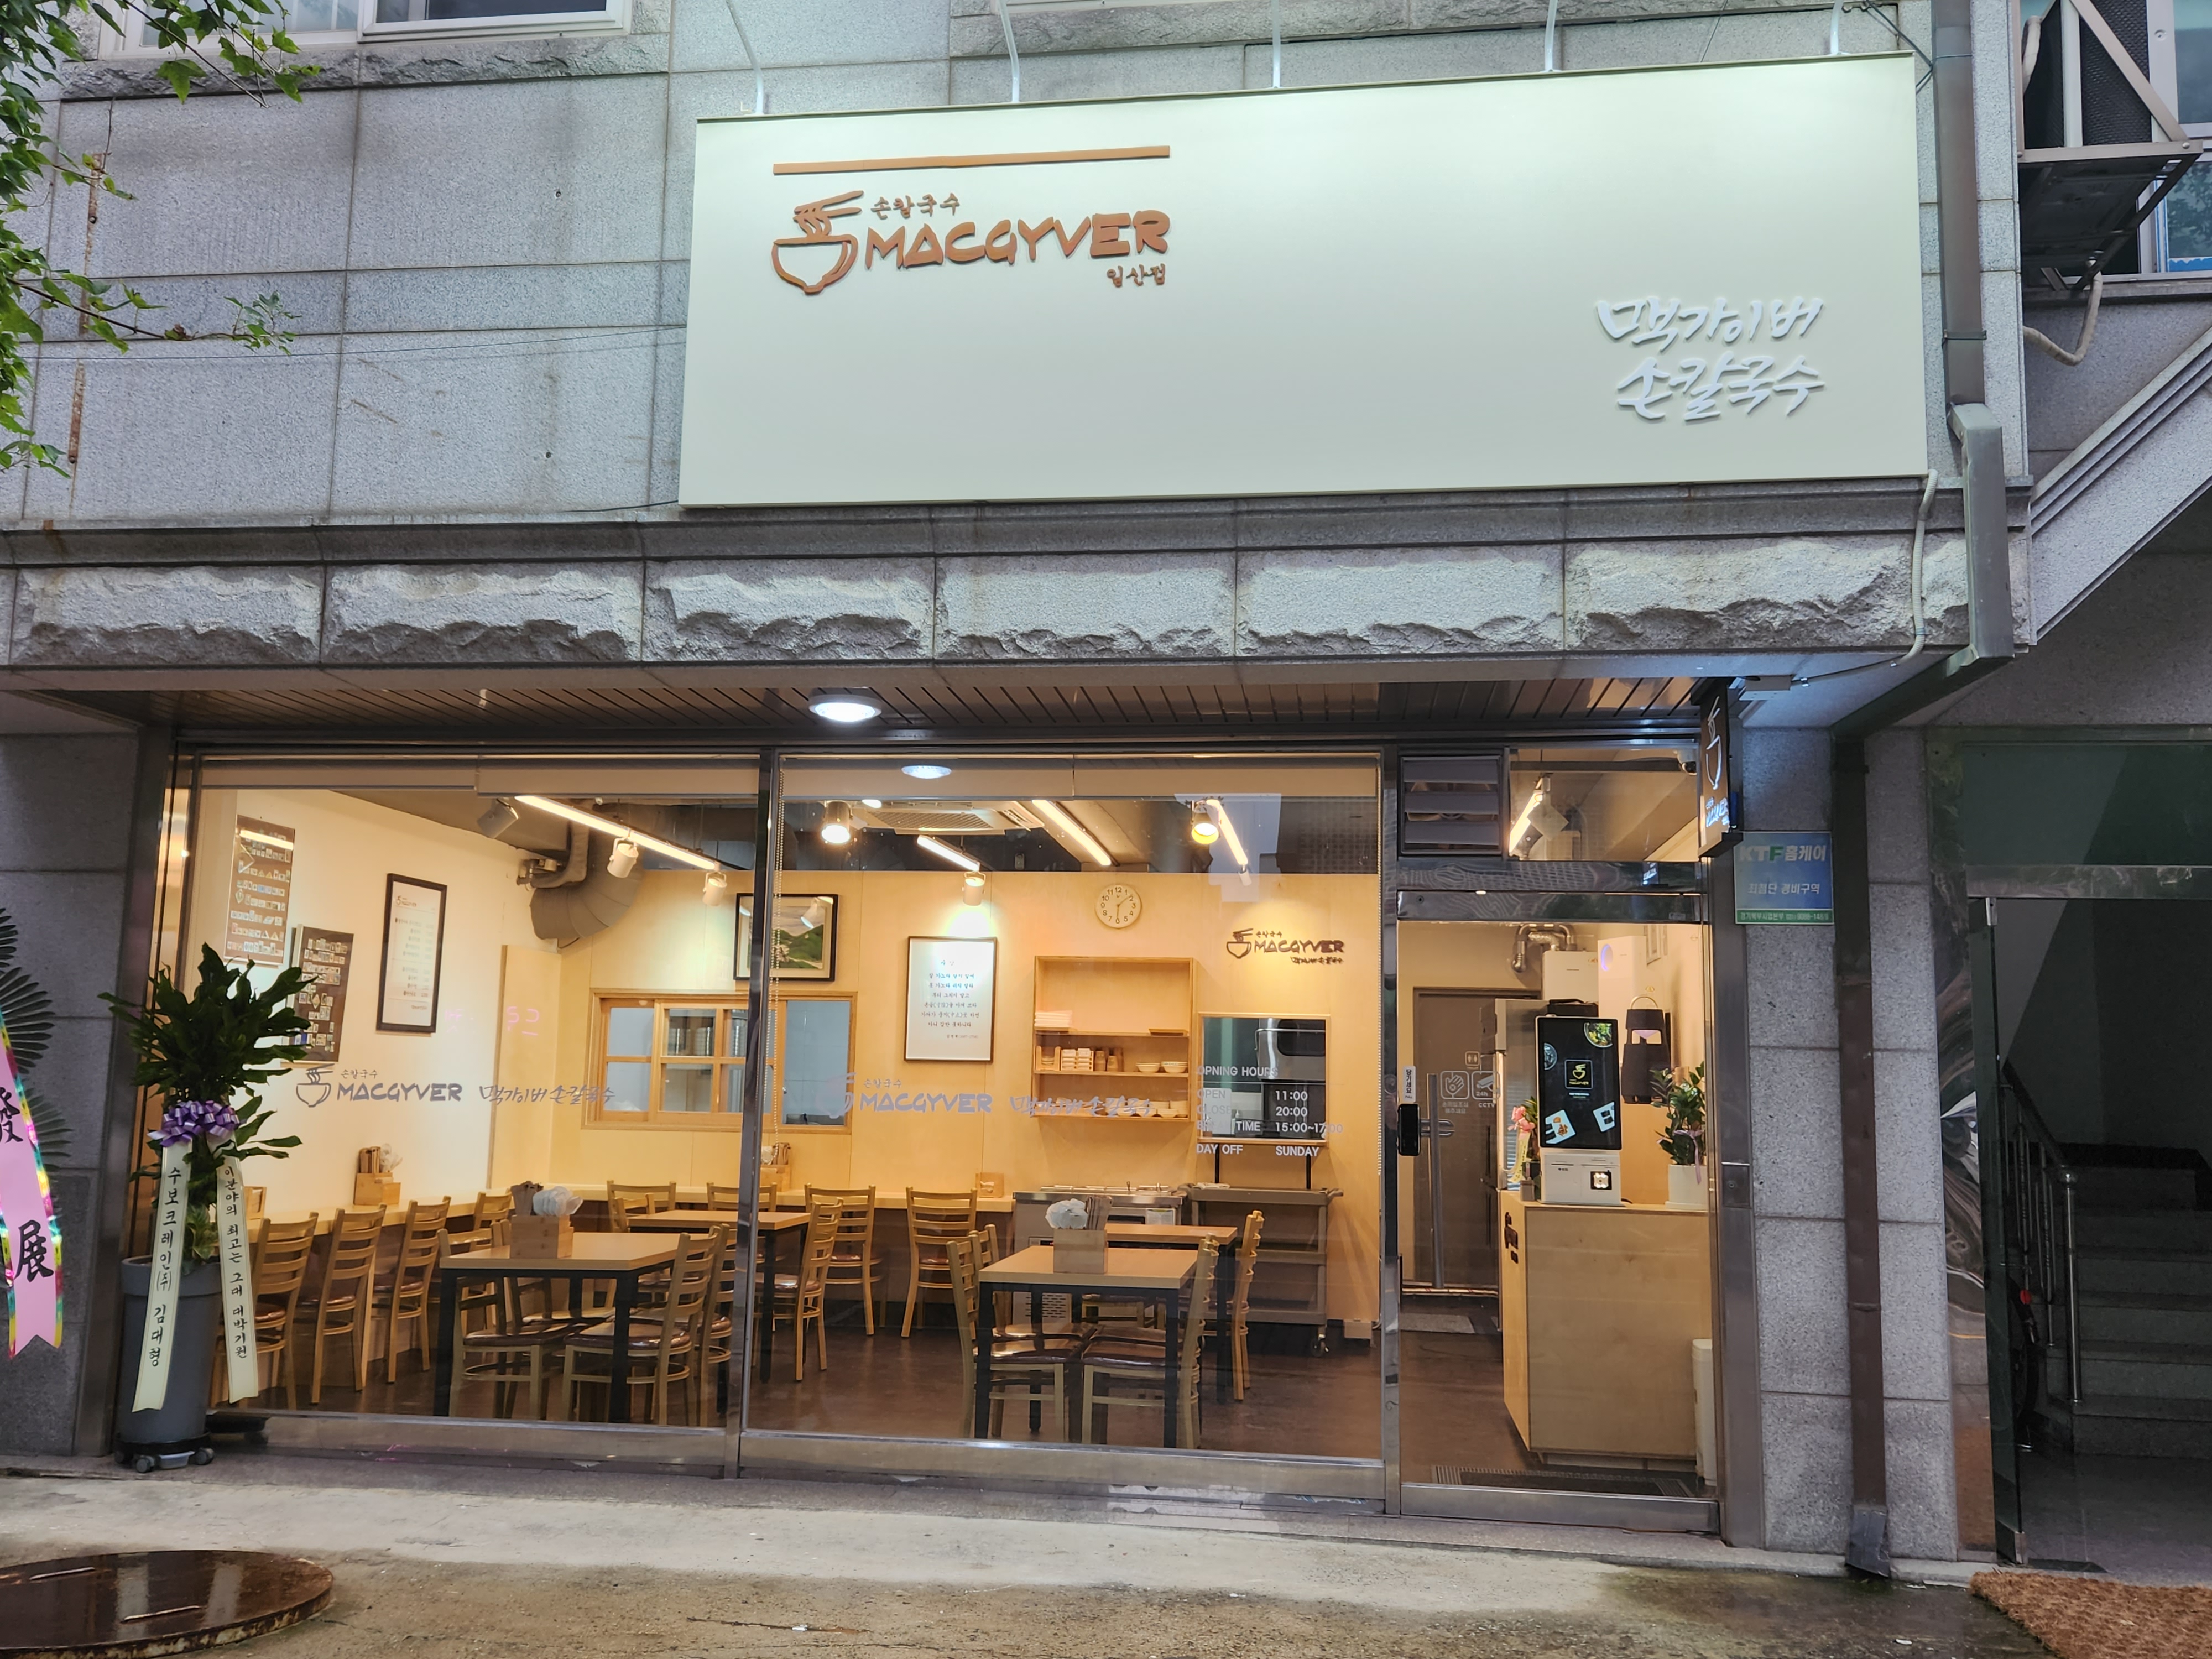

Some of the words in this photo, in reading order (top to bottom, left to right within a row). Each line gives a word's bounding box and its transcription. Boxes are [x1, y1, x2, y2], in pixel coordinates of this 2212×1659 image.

[870, 192, 960, 220] 손칼국수
[865, 210, 1171, 269] MACGYVER
[1596, 296, 1824, 352] 맥가이버
[1617, 351, 1825, 422] 손칼국수
[1781, 883, 1820, 895] 경비구역
[1254, 940, 1344, 954] MACGYVER
[340, 1069, 378, 1079] 손칼국수
[1241, 1066, 1278, 1077] HOURS
[863, 1078, 902, 1089] 손칼국수
[337, 1082, 463, 1102] MACGYVER
[1197, 1089, 1225, 1099] OPEN
[1275, 1091, 1308, 1101] 11:00
[859, 1092, 993, 1114] MACGYVER
[1275, 1107, 1308, 1117] 20:00
[1236, 1121, 1261, 1131] TIME
[1196, 1144, 1218, 1154] DAY
[1222, 1144, 1243, 1154] OFF
[1275, 1146, 1319, 1156] SUNDAY
[227, 1224, 243, 1264] 최고는
[230, 1272, 243, 1297] 그대
[149, 1304, 166, 1368] 김대형
